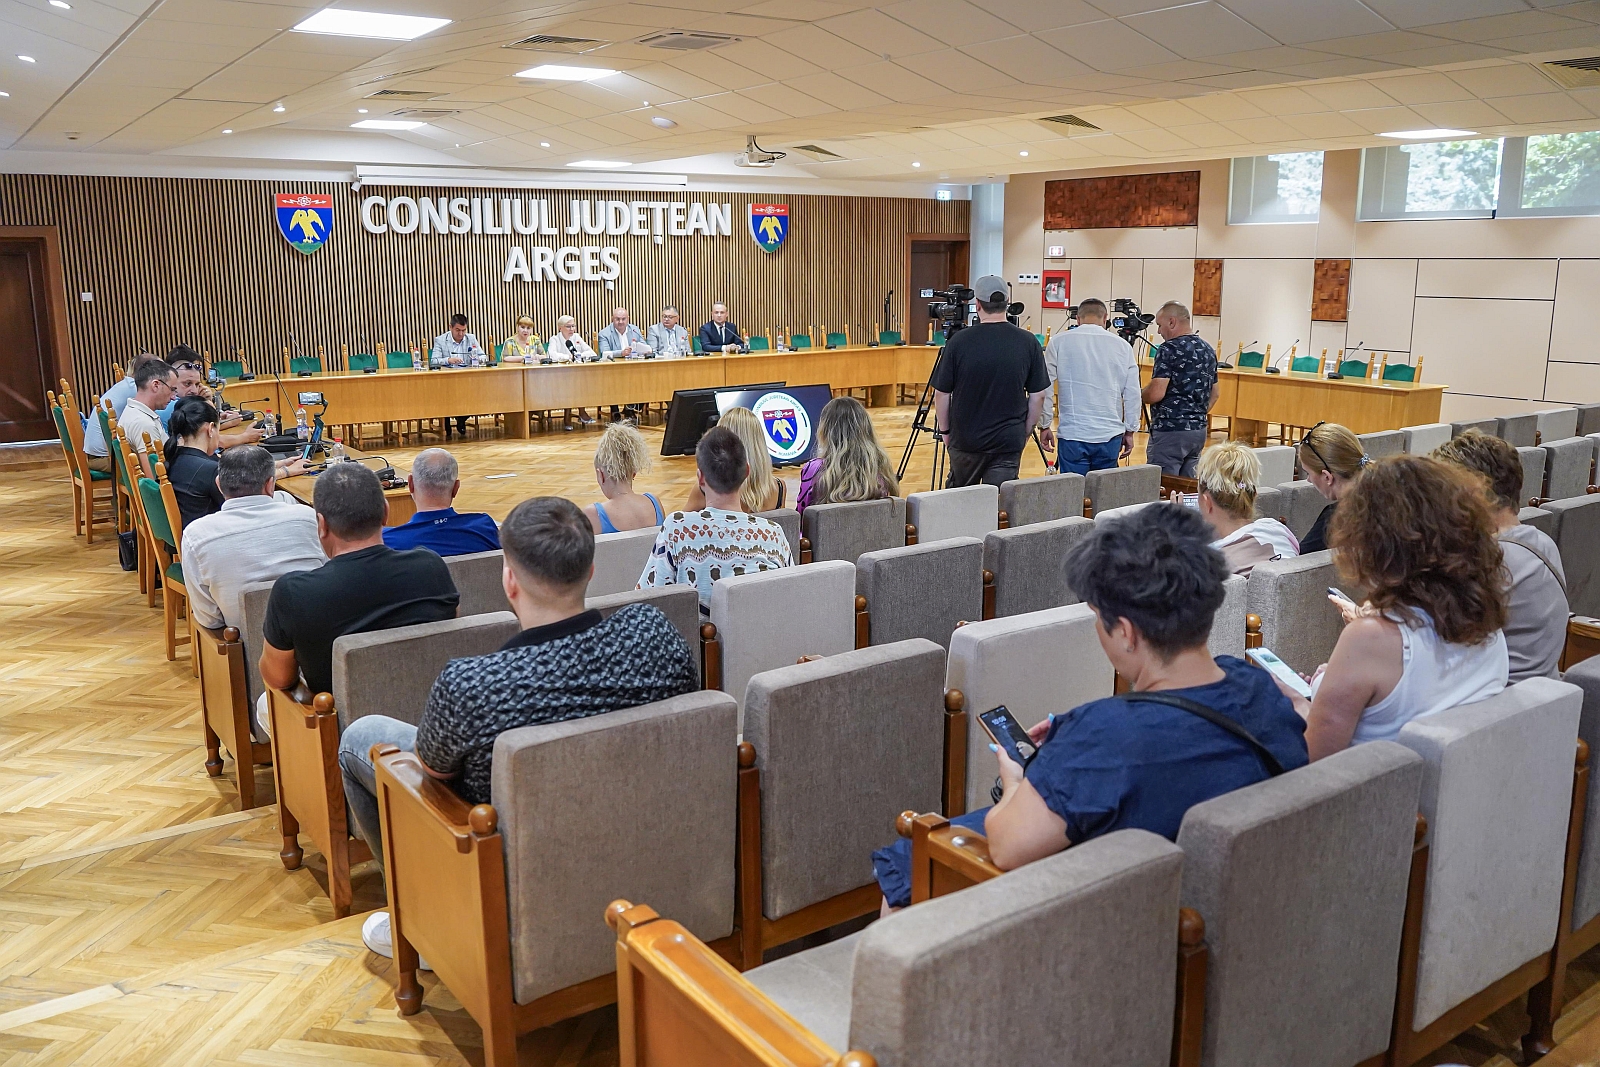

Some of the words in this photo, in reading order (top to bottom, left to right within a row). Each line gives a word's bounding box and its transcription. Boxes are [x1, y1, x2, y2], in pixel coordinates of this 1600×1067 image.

[361, 196, 557, 235] CONSILIUL
[566, 199, 731, 245] JUDEȚEAN
[503, 246, 620, 291] ARGEȘ
